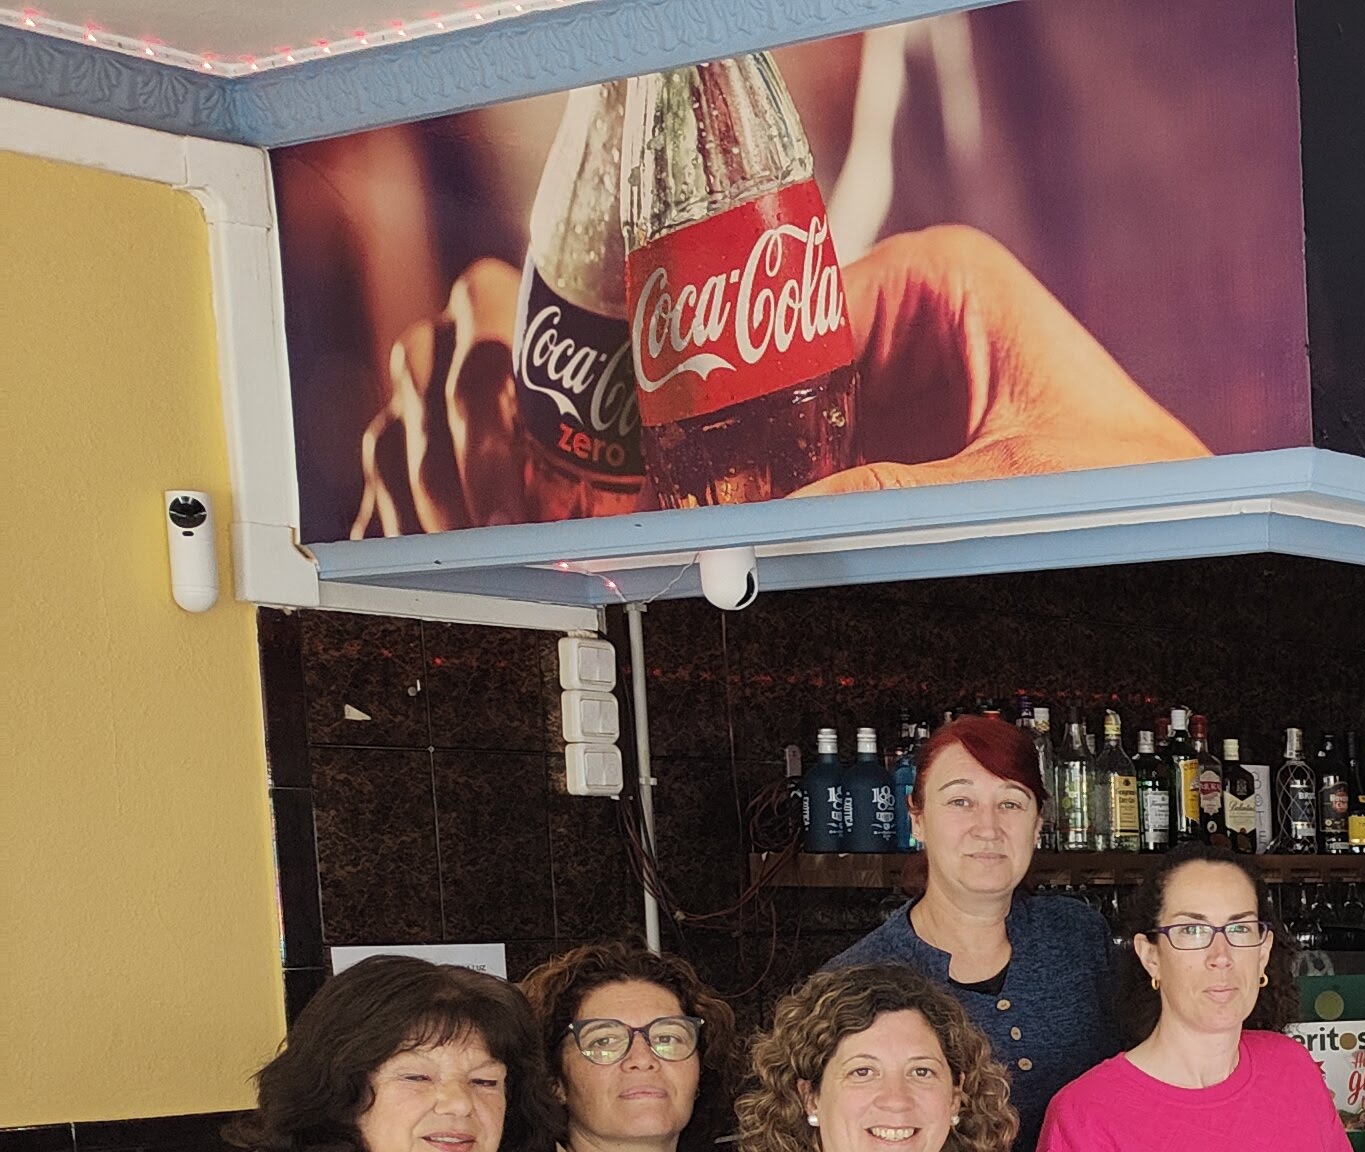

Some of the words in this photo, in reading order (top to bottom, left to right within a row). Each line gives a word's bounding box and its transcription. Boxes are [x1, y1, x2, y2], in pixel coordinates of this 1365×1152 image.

[632, 214, 845, 392] Coca-Cola
[522, 306, 640, 436] Coca-Co
[559, 423, 625, 466] zero
